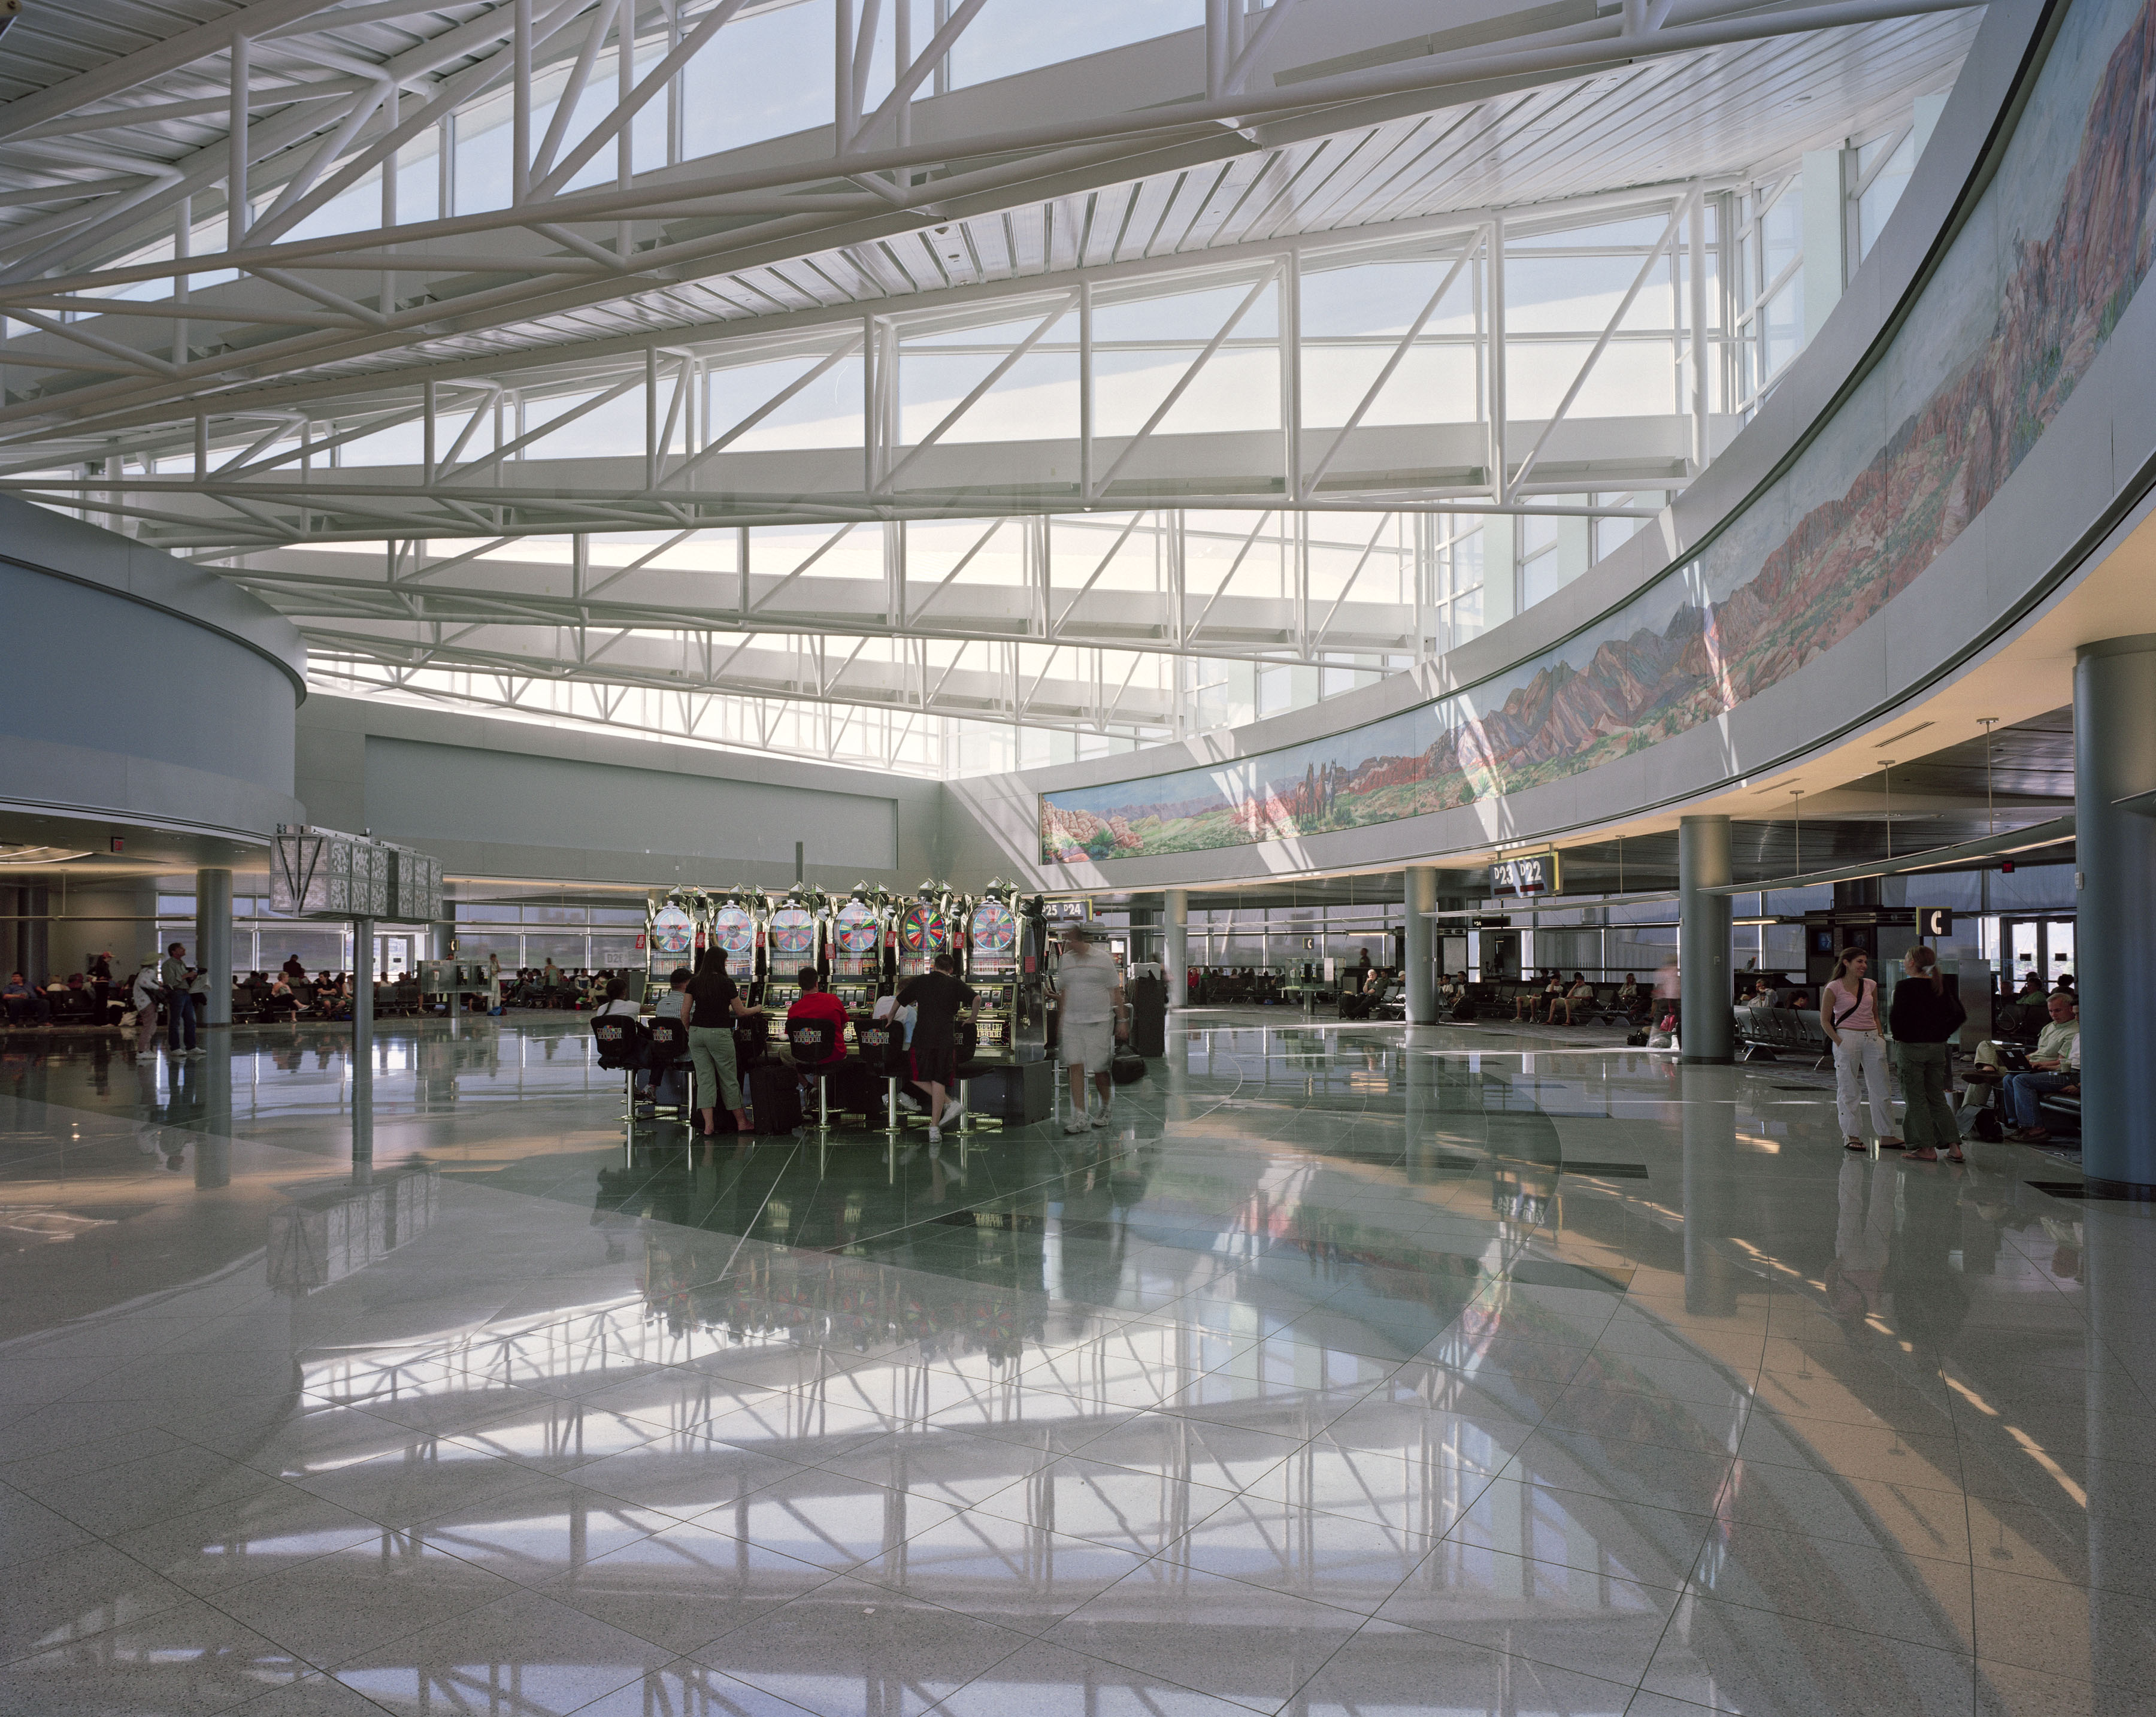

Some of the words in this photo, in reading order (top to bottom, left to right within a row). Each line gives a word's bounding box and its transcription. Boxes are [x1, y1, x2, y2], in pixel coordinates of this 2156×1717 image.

[1494, 865, 1513, 885] D23
[1520, 861, 1542, 882] D22
[1064, 904, 1081, 915] D24
